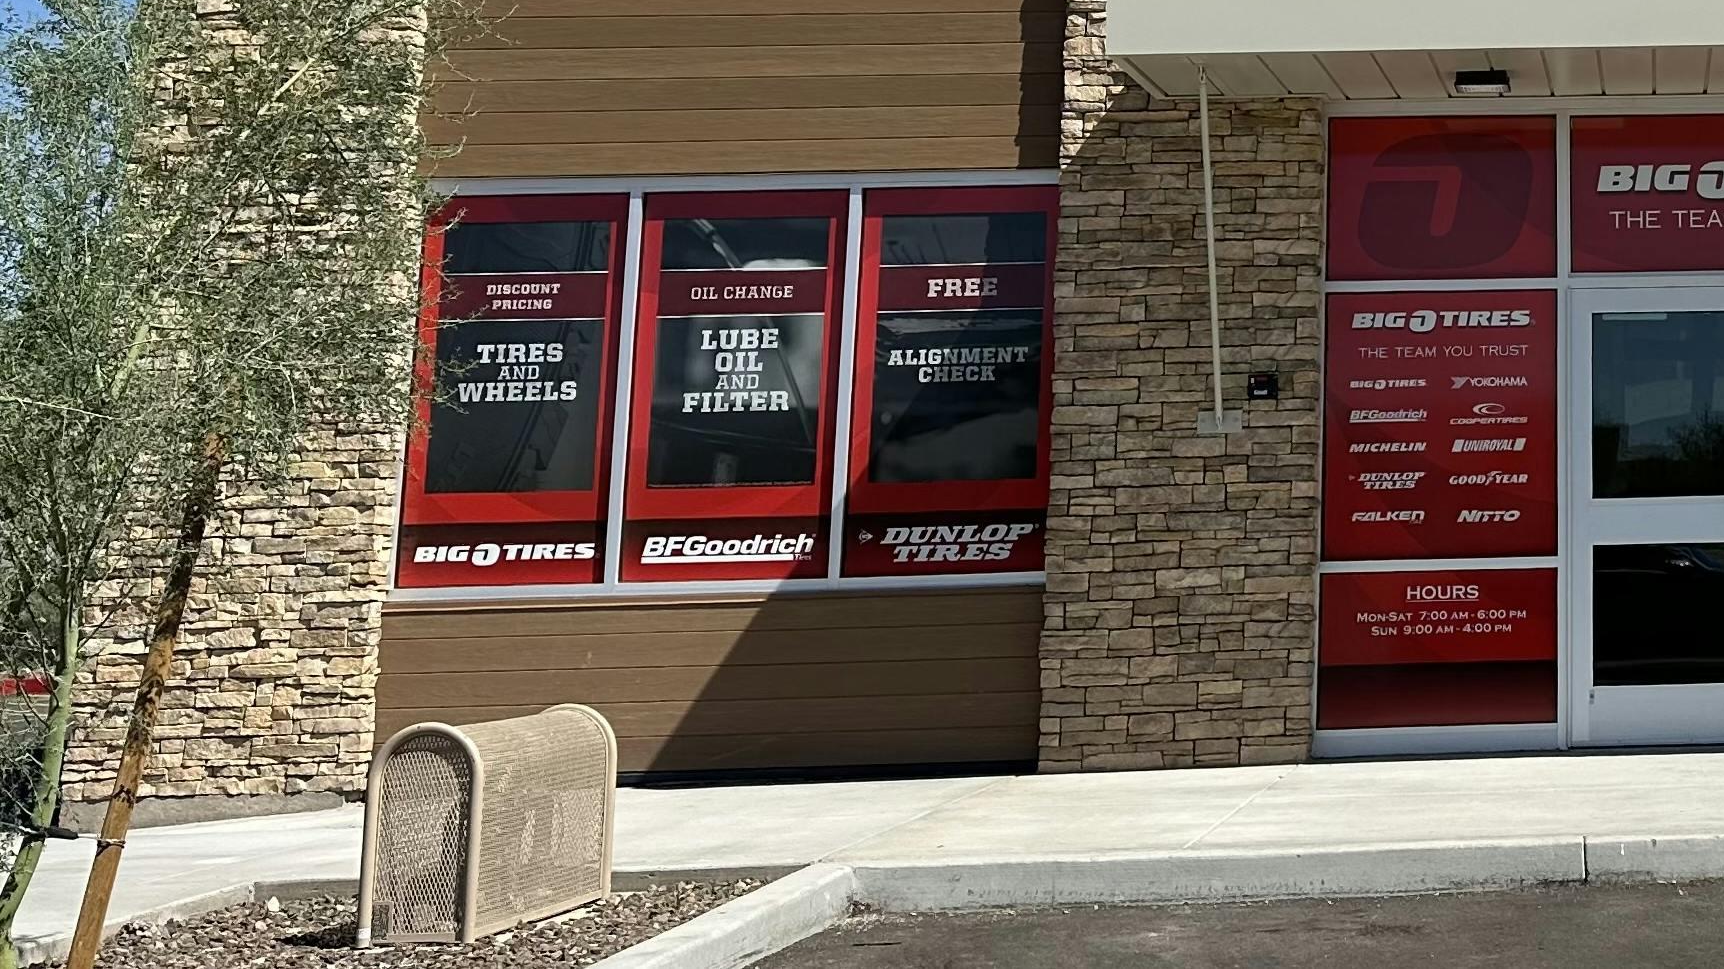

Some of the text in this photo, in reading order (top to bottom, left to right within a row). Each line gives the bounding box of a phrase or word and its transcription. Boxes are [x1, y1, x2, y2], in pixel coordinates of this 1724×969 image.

[1597, 165, 1691, 192] BIG
[1609, 210, 1662, 228] THE
[486, 284, 561, 295] DISCOUNT
[691, 285, 794, 300] OIL CHANGE
[927, 278, 998, 298] FREE
[492, 299, 552, 310] PRICING
[1352, 310, 1531, 332] BIG O TIRES
[700, 328, 779, 350] LUBE
[476, 343, 564, 364] TIRES
[887, 346, 1029, 366] ALIGNMENT
[1358, 345, 1528, 359] THE TEAM YOU TRUST
[714, 351, 763, 372] OIL
[497, 365, 540, 381] AND
[918, 365, 996, 383] CHECK
[715, 374, 759, 390] AND
[1350, 380, 1373, 389] BIG
[1386, 379, 1427, 388] TIRES
[1469, 376, 1528, 387] YOKOHAMA
[458, 381, 577, 403] WHEELS
[682, 390, 789, 413] FILTER
[1350, 409, 1427, 421] BFGoodrich
[1349, 442, 1427, 453] MICHELIN
[1463, 439, 1514, 452] UNIROYAL
[1358, 472, 1426, 482] DUNLOP
[1364, 481, 1416, 490] TIRES
[1457, 510, 1521, 523] NITTO
[880, 524, 1034, 545] DUNLOP
[642, 534, 814, 557] BFGoodrich
[893, 543, 1013, 563] TIRES
[413, 543, 596, 566] BIG O TIRES
[1406, 585, 1479, 600] HOURS
[1419, 611, 1448, 621] 7:00
[1450, 612, 1469, 620] AM
[1477, 610, 1506, 620] 6:00
[1509, 610, 1527, 619] PM
[1371, 626, 1397, 636] SUN
[1403, 625, 1433, 635] 9:00
[1435, 625, 1454, 634] AM
[1462, 623, 1492, 633] 4:00
[1494, 624, 1512, 632] PM
